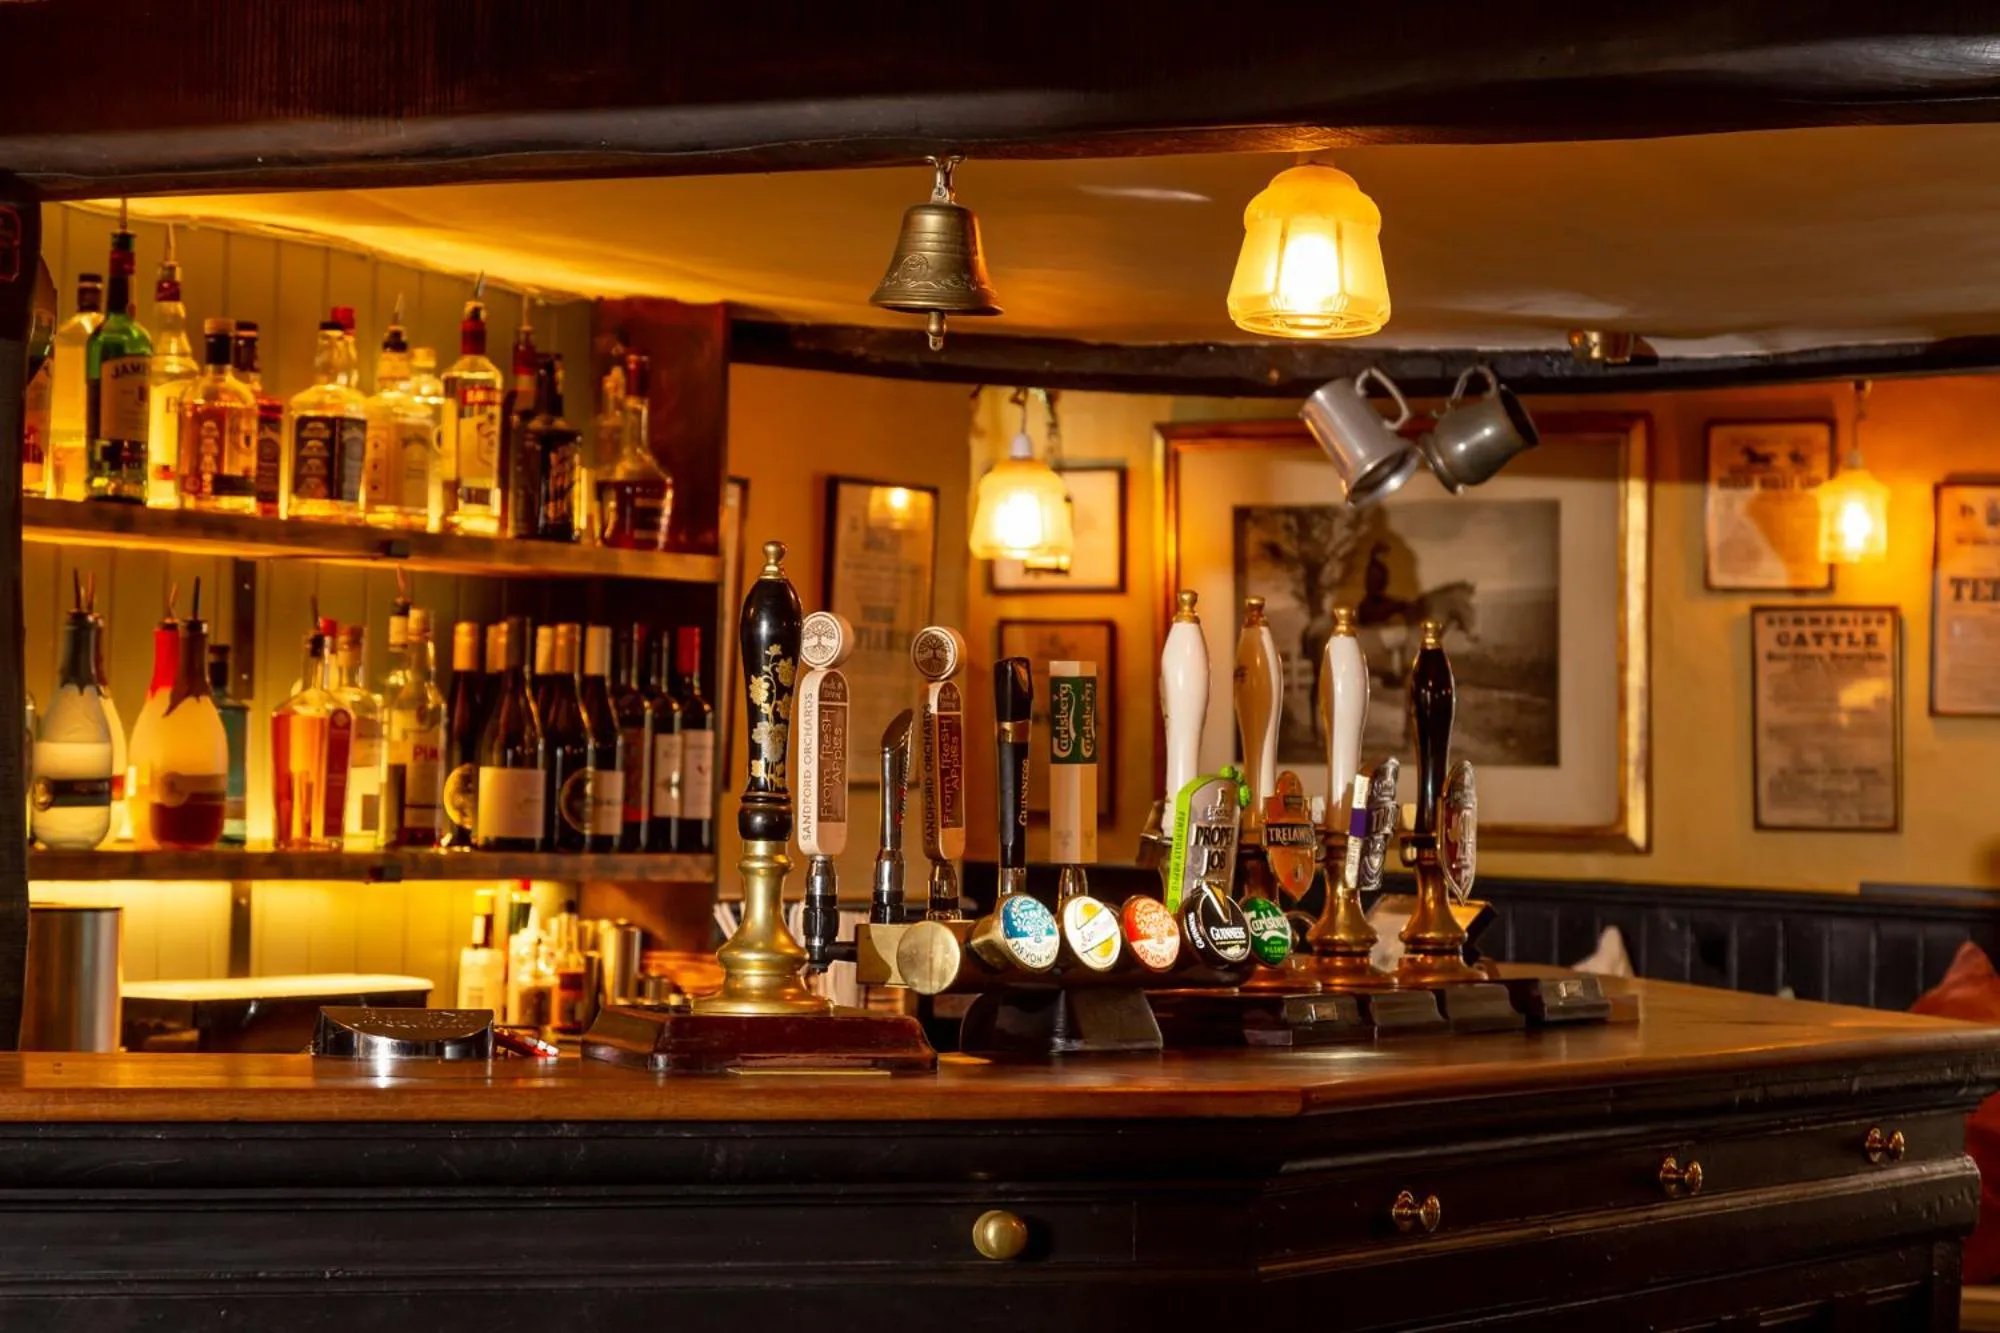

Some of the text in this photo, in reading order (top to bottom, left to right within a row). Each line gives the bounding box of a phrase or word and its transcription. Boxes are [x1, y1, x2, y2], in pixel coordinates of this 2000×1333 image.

[1776, 631, 1879, 648] CATTLE
[1052, 682, 1073, 758] Carlsberg
[802, 692, 814, 841] SANDFORD ORCHARDS
[924, 702, 937, 849] SANDFORD ORCHARDS
[1201, 849, 1226, 878] JOB
[1209, 926, 1247, 941] GUINNESS
